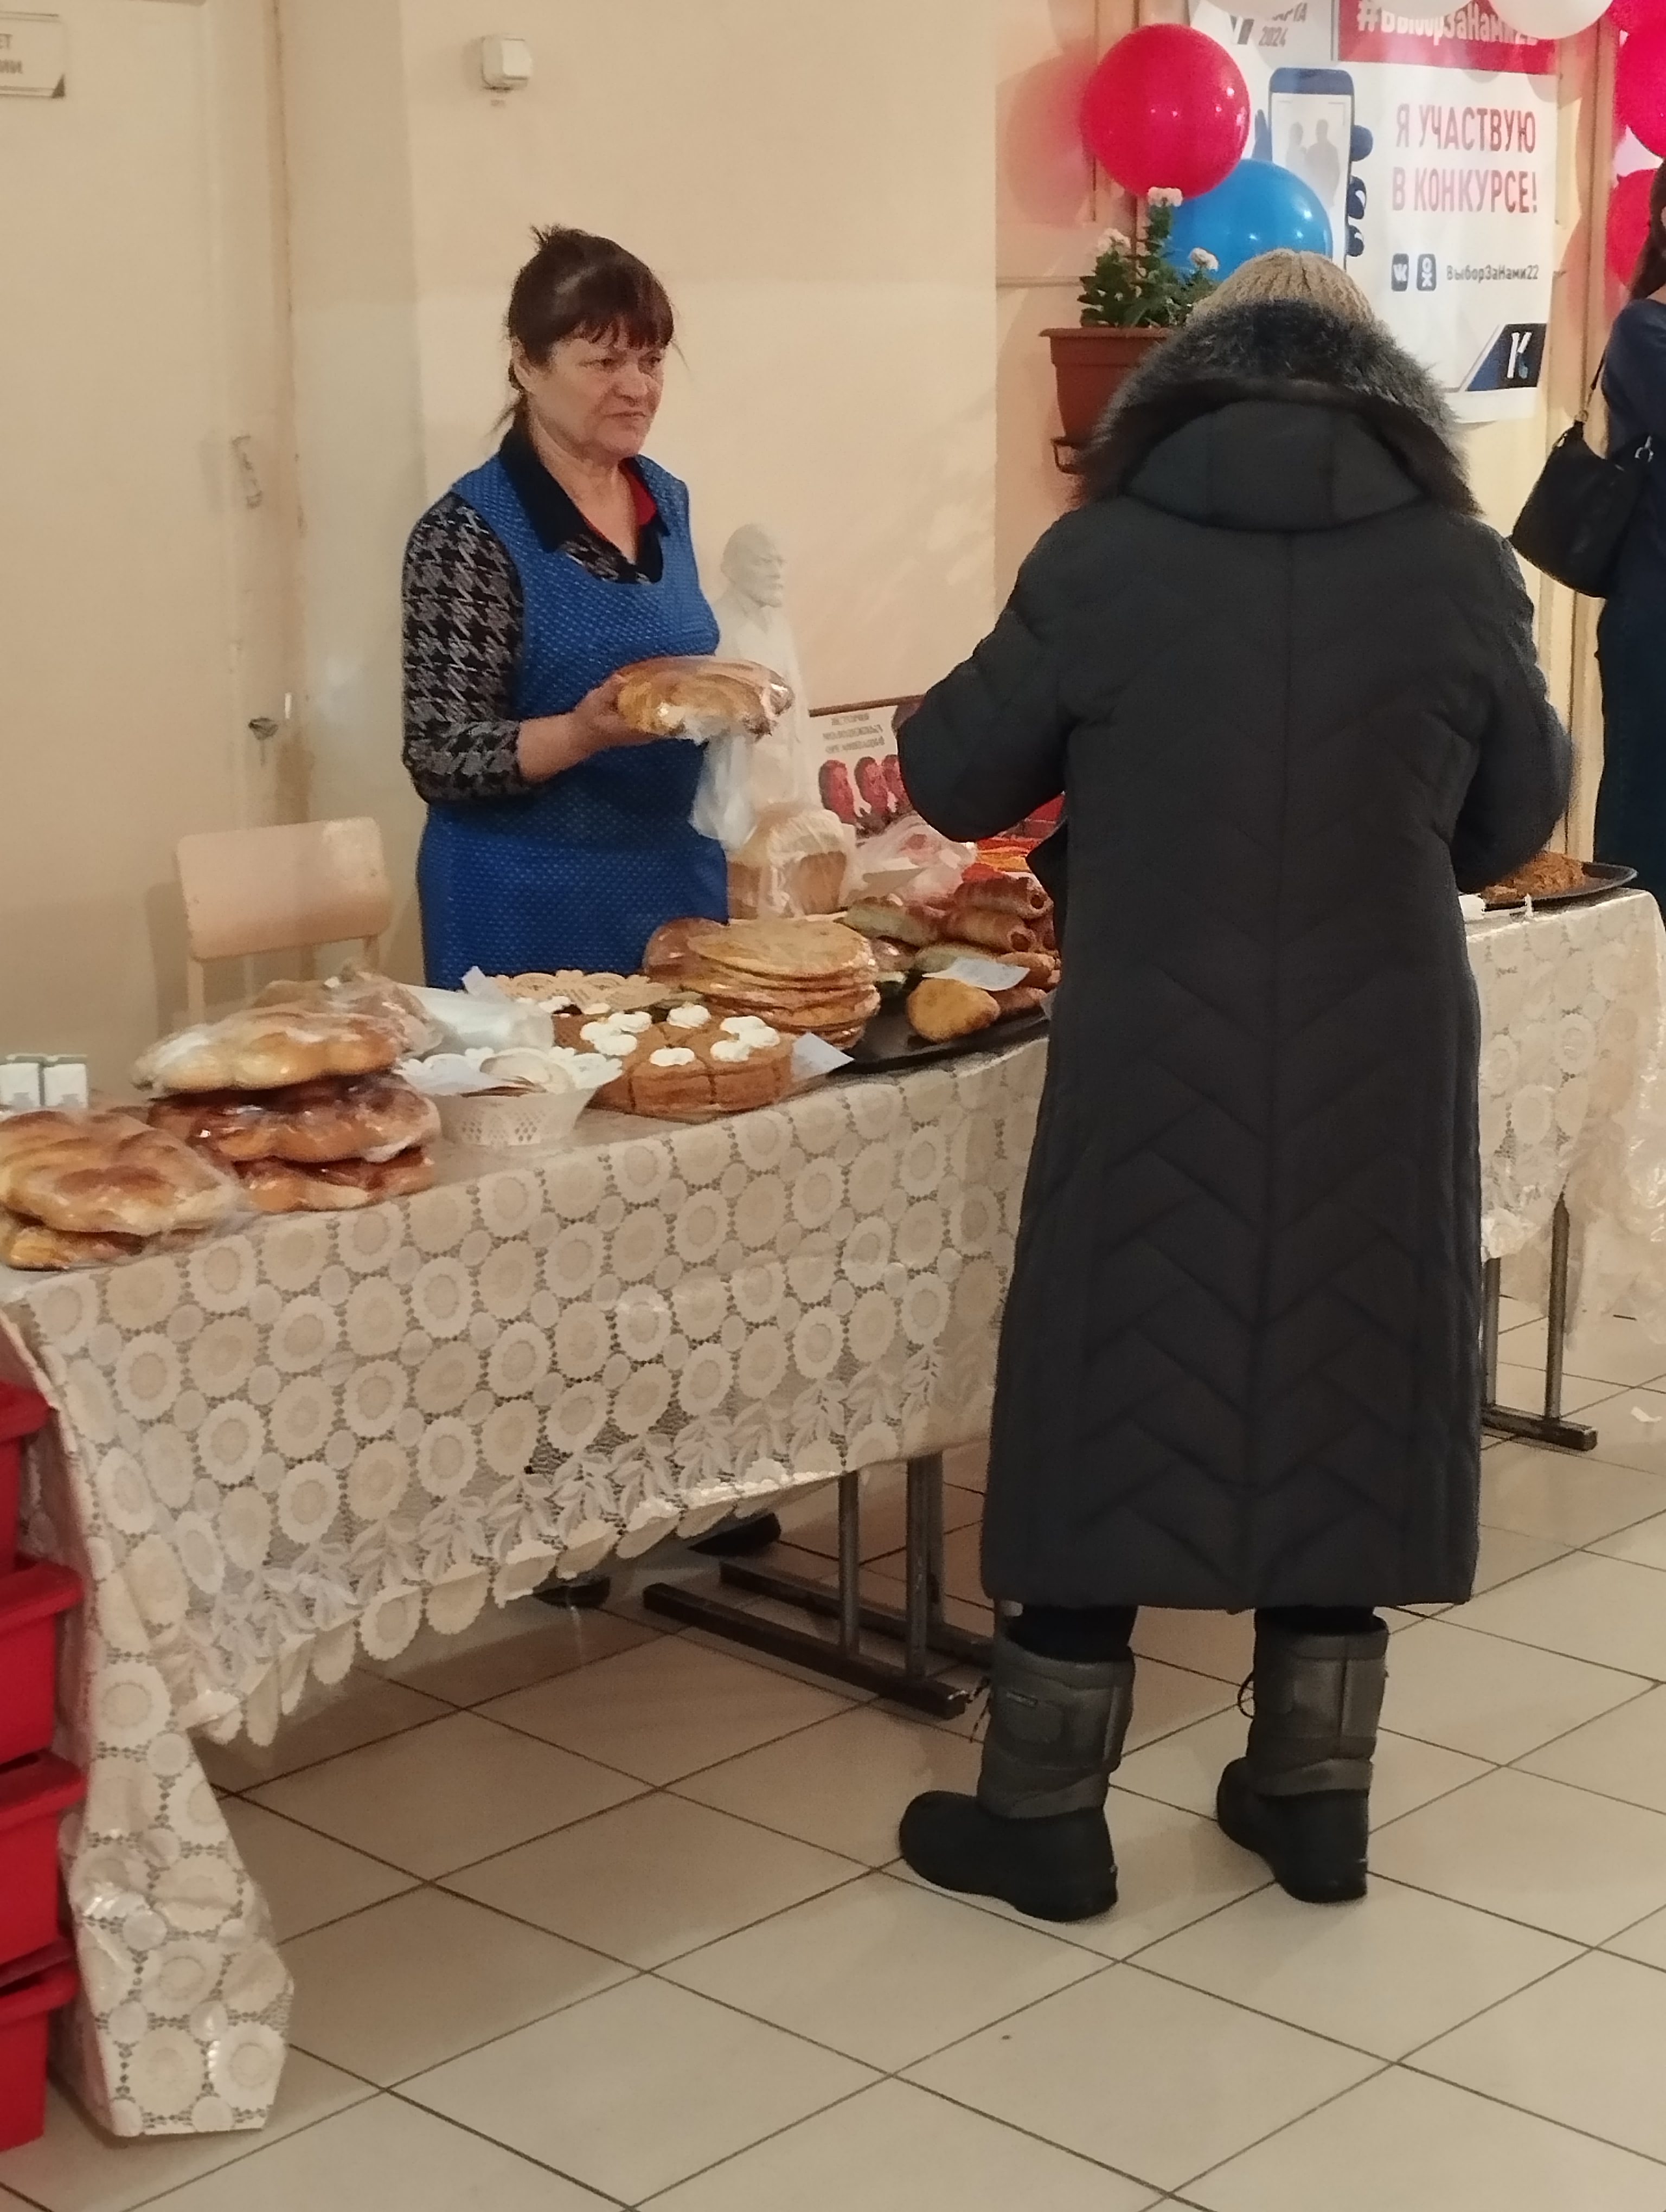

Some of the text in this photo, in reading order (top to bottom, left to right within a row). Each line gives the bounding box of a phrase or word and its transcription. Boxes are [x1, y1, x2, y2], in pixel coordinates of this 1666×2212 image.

[1396, 103, 1536, 153] Я УЧАСТВУЮ
[1392, 166, 1537, 214] В КОНКУРСЕ!
[1446, 264, 1539, 284] ВыборЗаНами22
